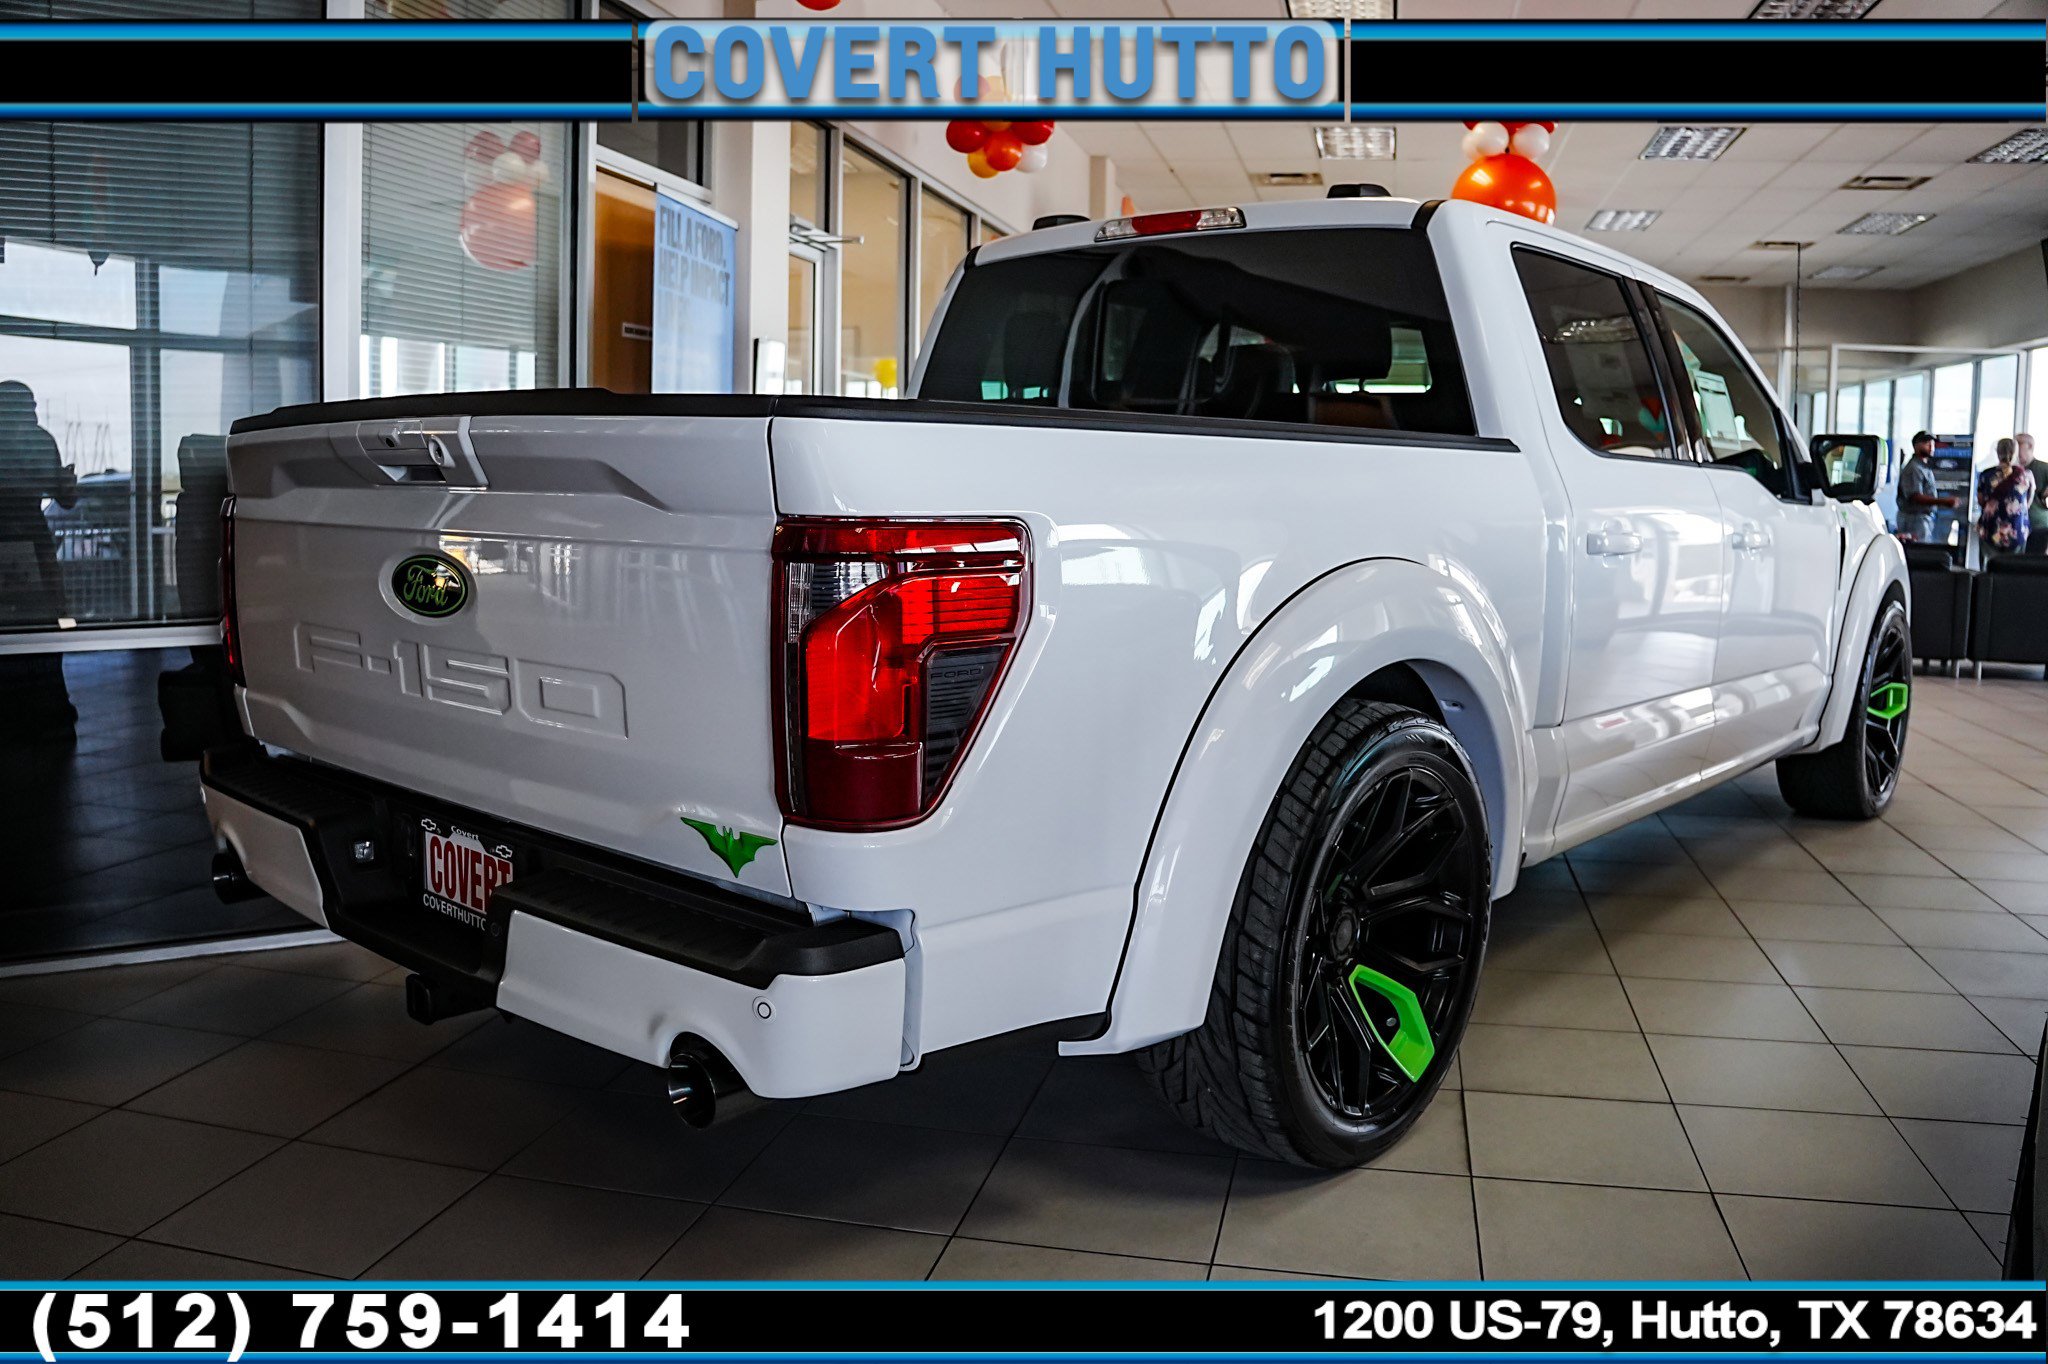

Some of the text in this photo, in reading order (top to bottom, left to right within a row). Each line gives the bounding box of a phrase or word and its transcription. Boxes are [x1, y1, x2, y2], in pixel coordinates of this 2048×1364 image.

[660, 204, 683, 251] FILL
[685, 217, 693, 255] A
[403, 564, 449, 607] Ford
[294, 621, 629, 740] F-150
[930, 668, 982, 680] FORD
[450, 825, 480, 841] Covert
